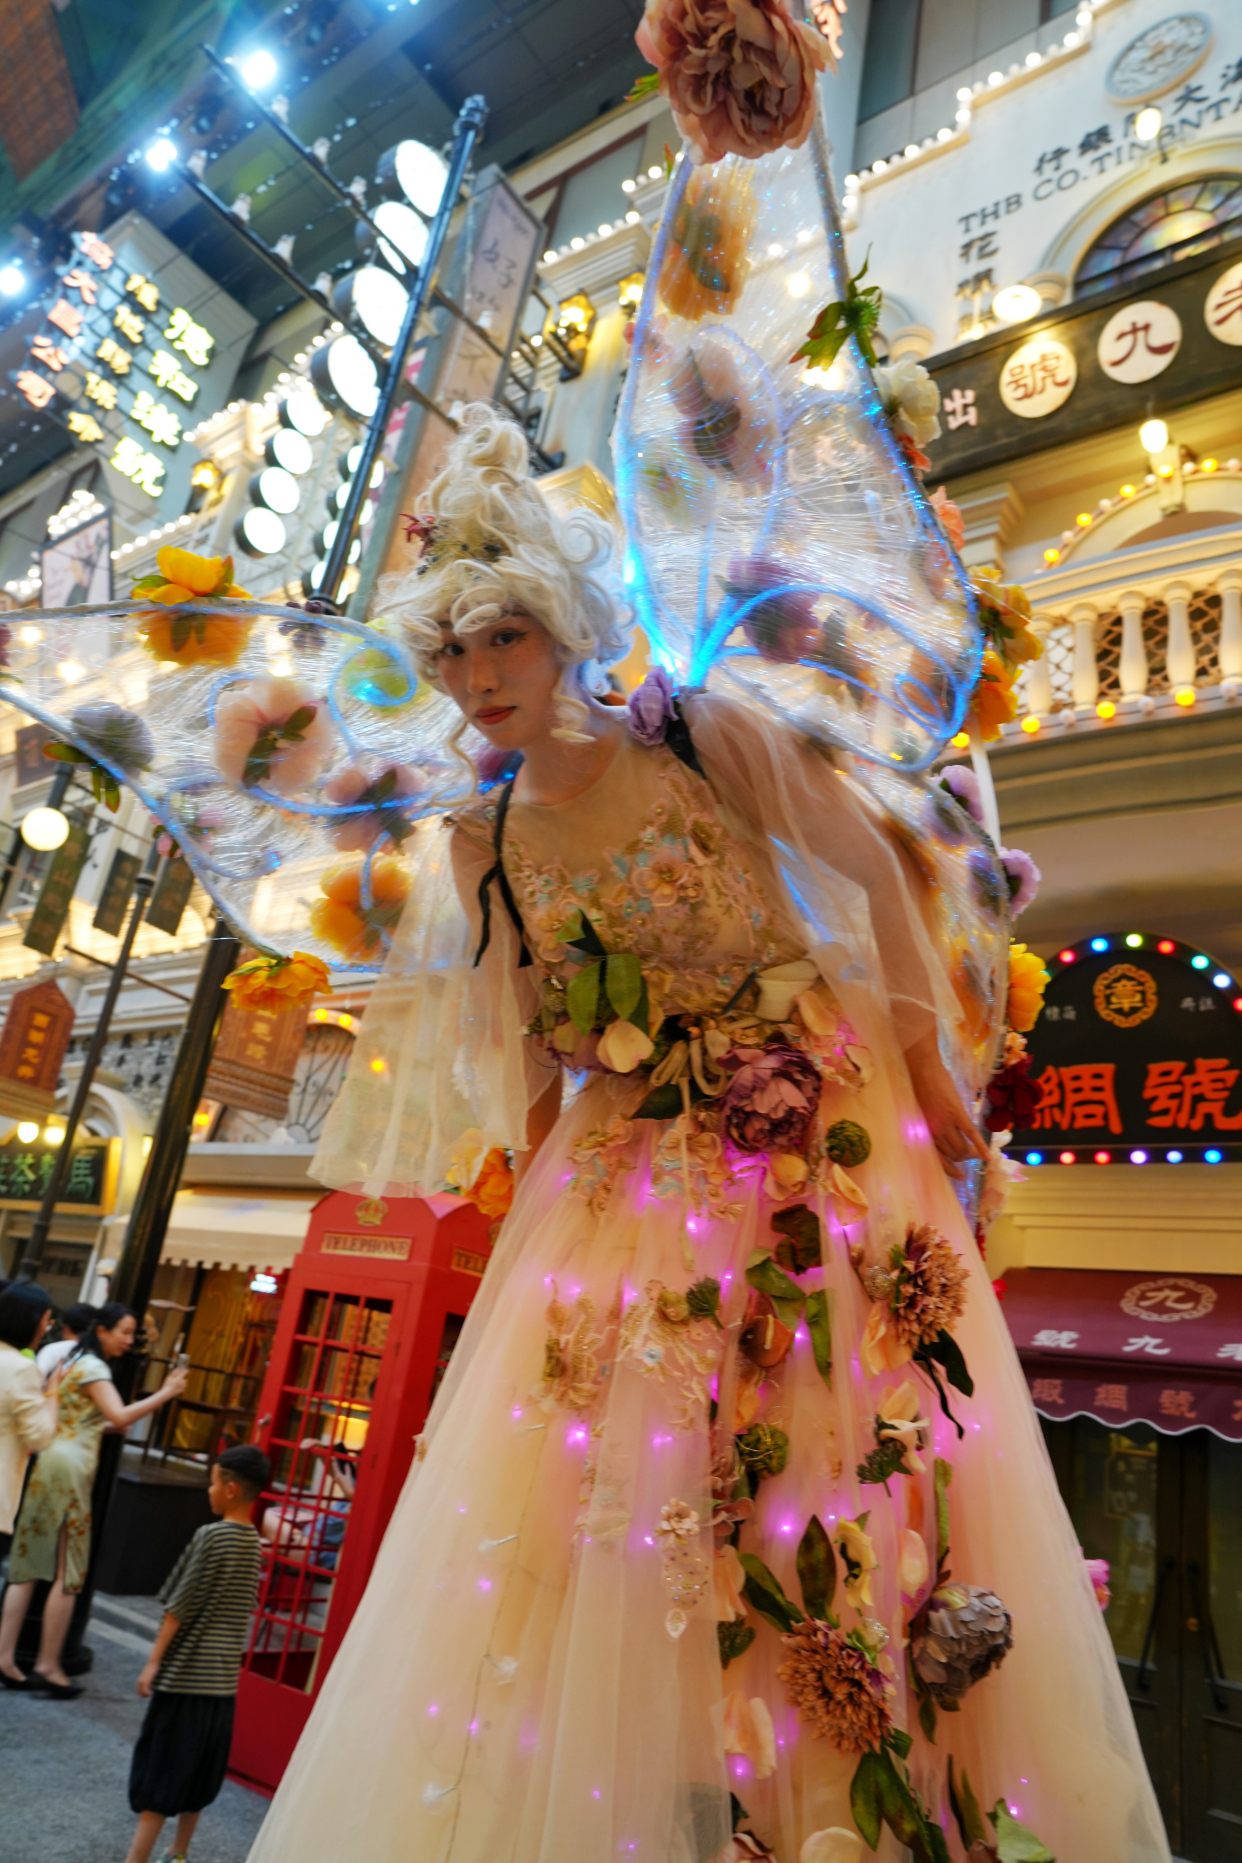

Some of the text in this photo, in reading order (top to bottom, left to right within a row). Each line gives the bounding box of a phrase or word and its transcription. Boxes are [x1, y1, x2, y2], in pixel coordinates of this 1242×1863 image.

[943, 387, 979, 430] 出
[324, 1235, 410, 1256] TELEPHONE
[1139, 1287, 1195, 1311] 九
